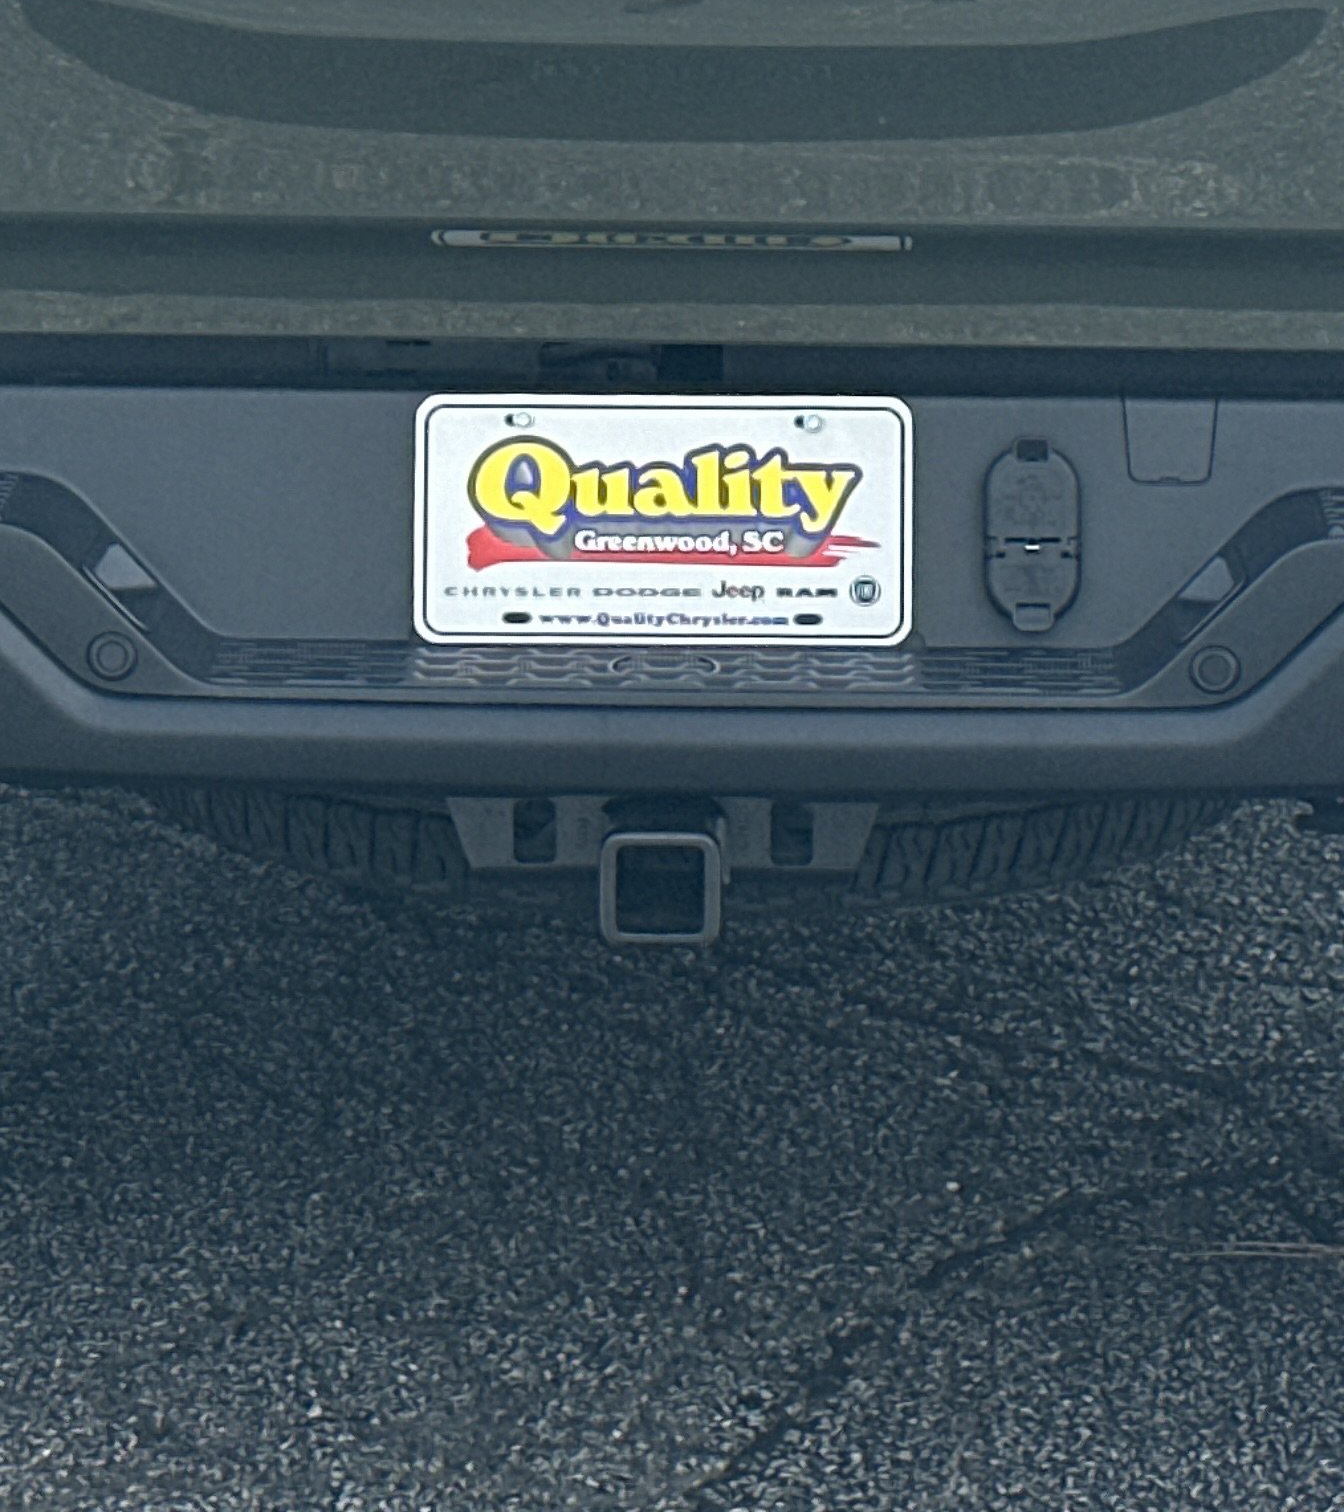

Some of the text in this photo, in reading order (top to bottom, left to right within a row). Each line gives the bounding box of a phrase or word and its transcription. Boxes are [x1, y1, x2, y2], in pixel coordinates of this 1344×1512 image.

[470, 436, 860, 537] Quality
[574, 529, 785, 557] Greenwood, SC
[443, 579, 839, 603] CHRYSLER DODGE Jeep RAM
[538, 611, 790, 628] www.QualityChrysler.com
